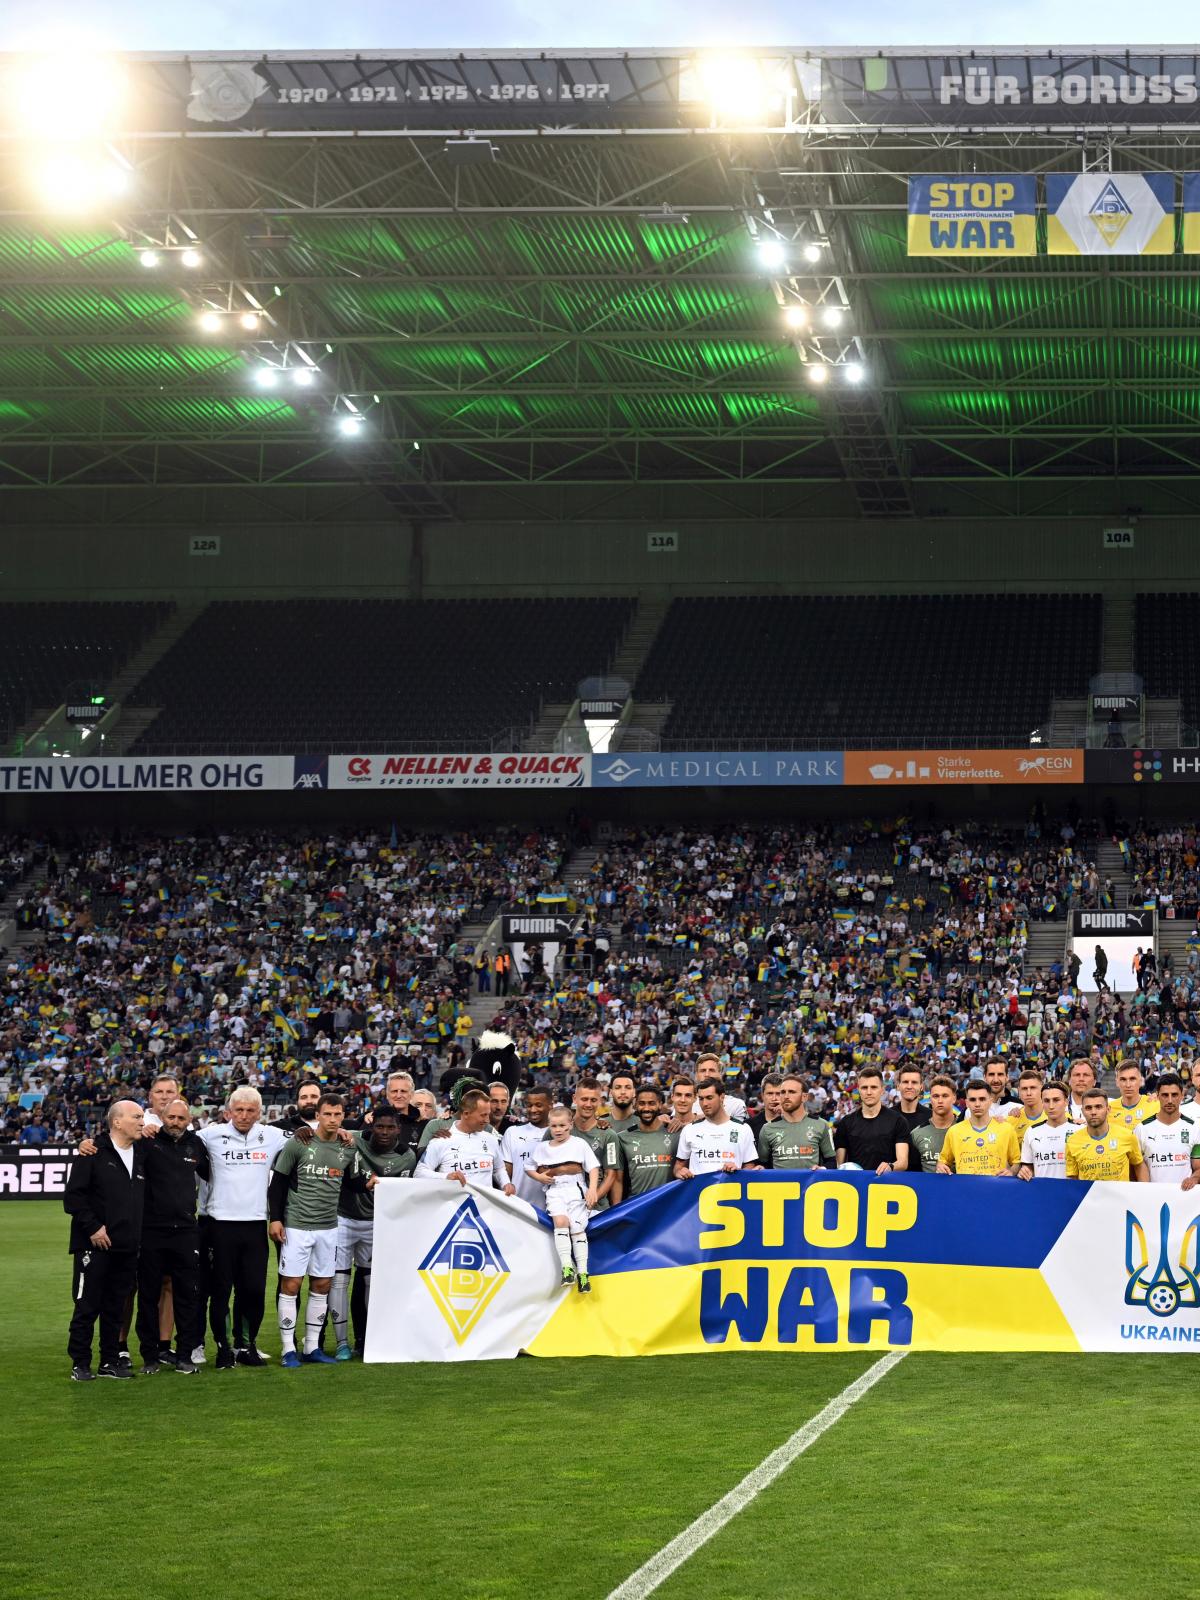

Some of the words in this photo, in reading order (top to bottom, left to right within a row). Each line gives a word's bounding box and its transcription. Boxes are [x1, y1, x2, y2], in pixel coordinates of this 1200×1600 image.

[277, 88, 329, 103] 1970
[349, 87, 398, 102] 1971
[419, 86, 468, 100] 1975
[489, 84, 539, 99] 1976
[561, 83, 610, 99] 1977
[940, 67, 1021, 105] FÜR
[930, 183, 1014, 208] STOP
[930, 221, 1015, 248] WAR
[651, 537, 674, 546] 11A
[1106, 533, 1130, 542] 10A
[193, 541, 216, 550] 12A
[581, 702, 612, 712] PUMA
[1094, 698, 1126, 708] PUMA
[67, 707, 99, 717] PUMA
[383, 757, 469, 774] NELLEN
[474, 757, 492, 774] &
[499, 756, 584, 774] QUACK
[646, 760, 762, 777] MEDICAL
[776, 760, 839, 777] PARK
[937, 756, 971, 767] Starke
[1046, 757, 1072, 769] EGN
[0, 766, 52, 790] TEN
[60, 764, 193, 789] VOLLMER
[200, 763, 264, 788] OHG
[937, 768, 1004, 778] Viererkette.
[294, 774, 323, 788] AXA
[510, 919, 555, 933] PUMA
[1081, 913, 1125, 928] PUMA
[1035, 1150, 1064, 1161] flate
[699, 1181, 918, 1249] STOP
[700, 1266, 913, 1345] WAR
